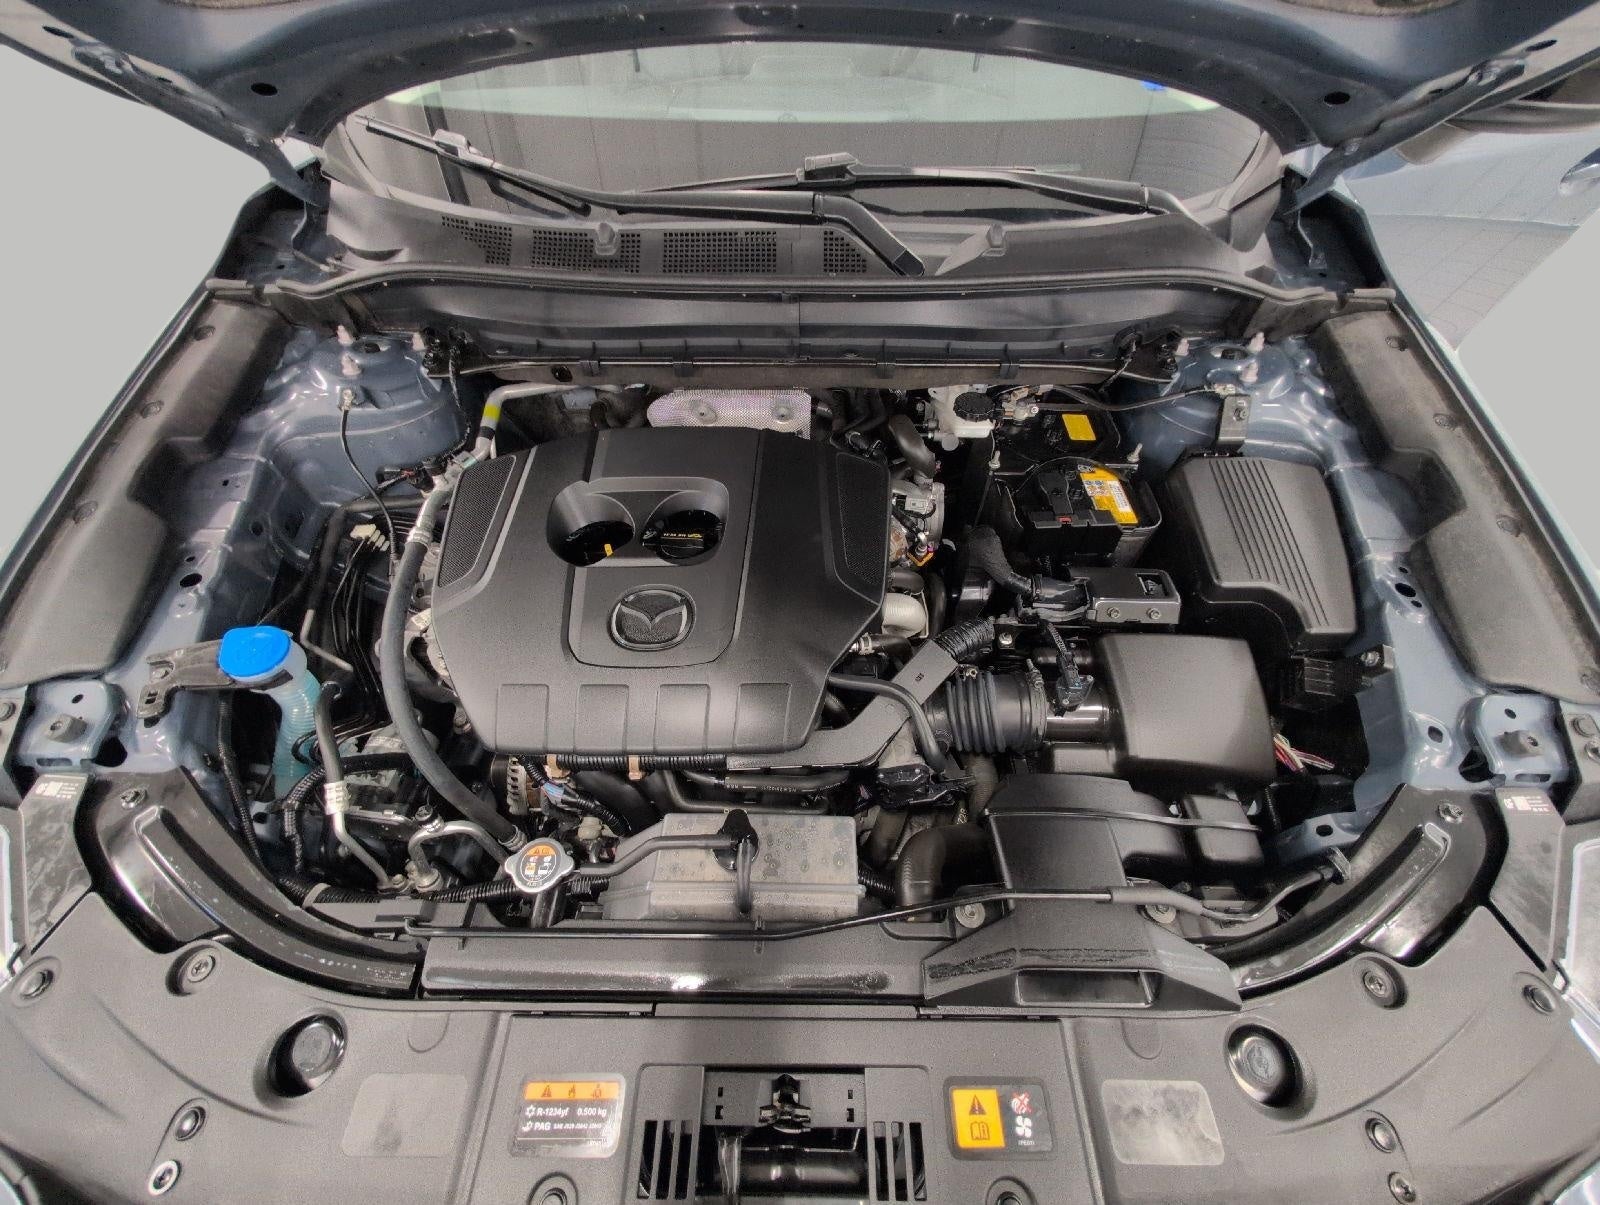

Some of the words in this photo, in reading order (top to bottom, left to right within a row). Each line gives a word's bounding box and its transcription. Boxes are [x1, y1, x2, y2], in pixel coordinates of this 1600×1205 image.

[536, 1107, 570, 1118] R-1234yf
[577, 1107, 597, 1117] 0.500
[597, 1107, 607, 1118] kg
[534, 1122, 551, 1131] PAG
